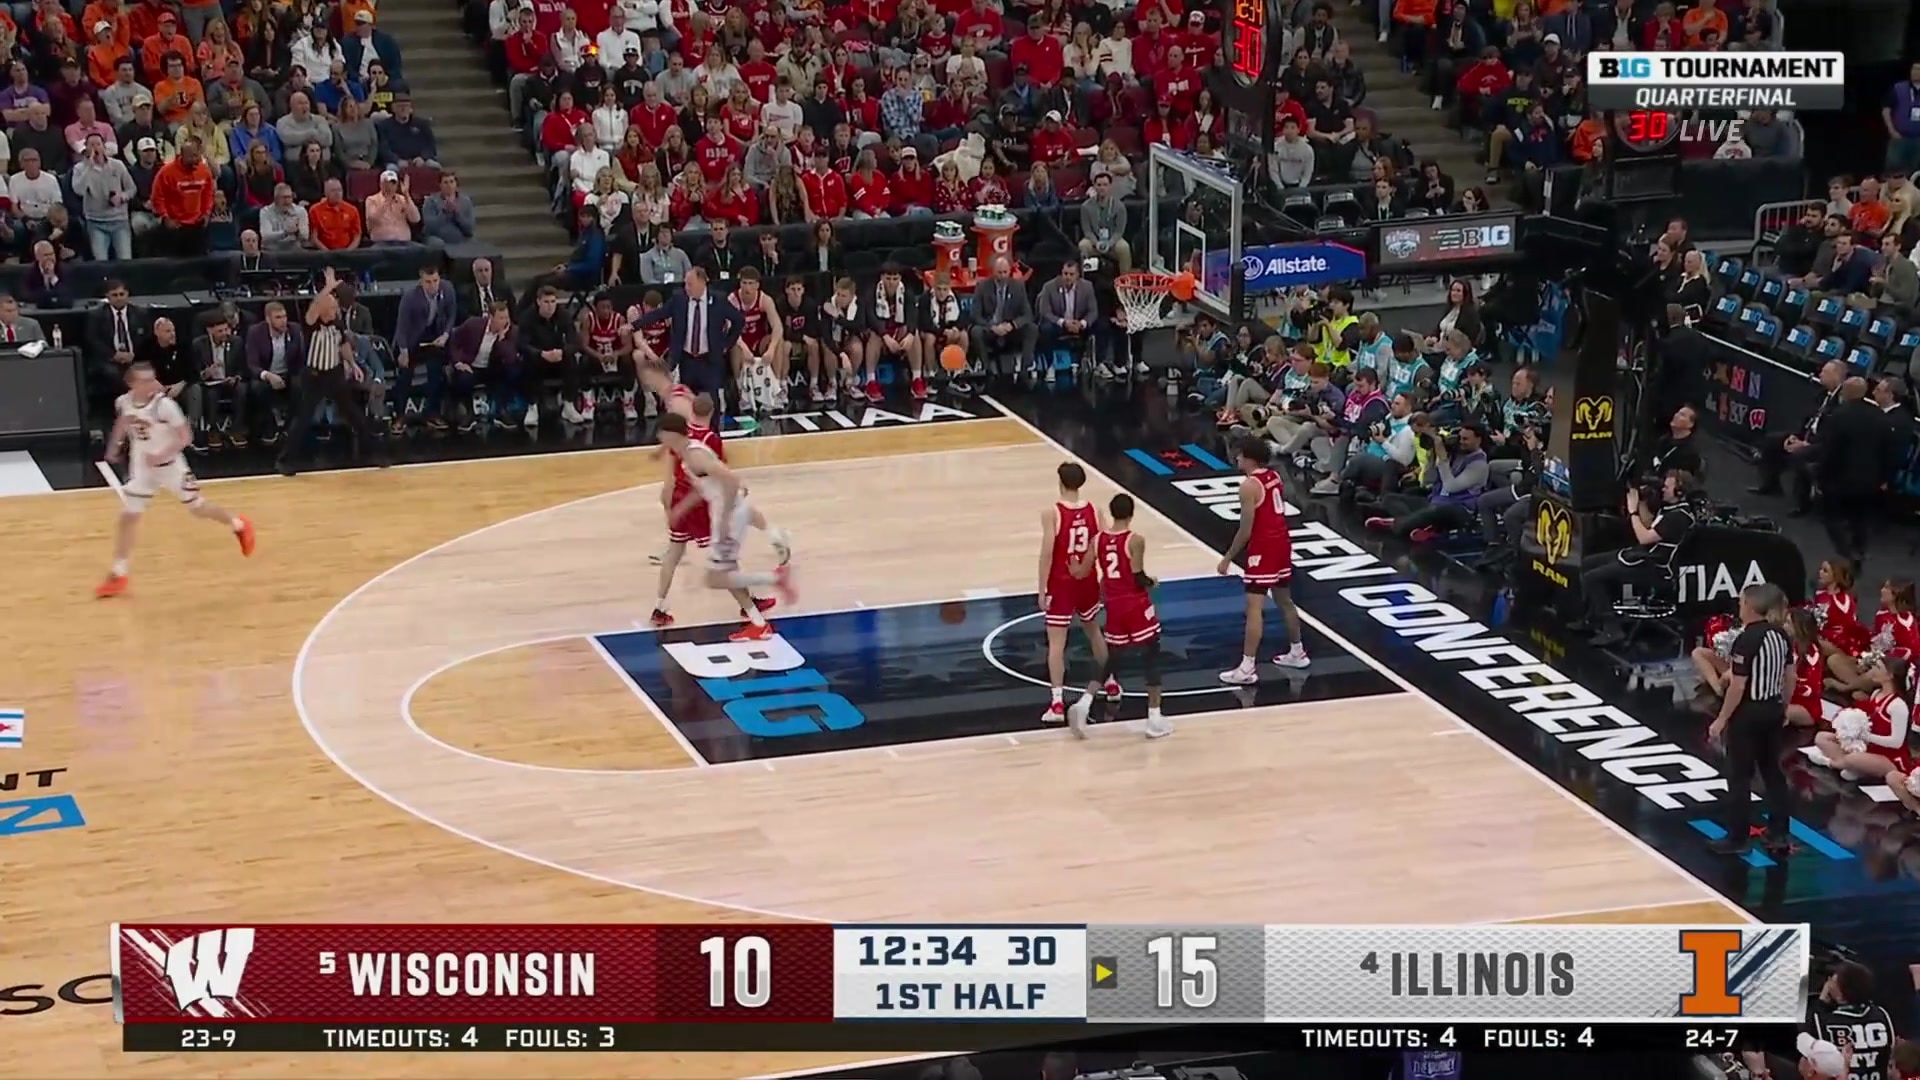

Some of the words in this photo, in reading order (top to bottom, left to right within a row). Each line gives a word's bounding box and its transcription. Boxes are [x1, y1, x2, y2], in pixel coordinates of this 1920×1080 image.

[1233, 20, 1263, 77] 30
[1627, 112, 1668, 141] 30
[993, 236, 1008, 253] G
[1264, 256, 1327, 275] Allstate
[771, 403, 975, 431] TIAA
[1572, 431, 1613, 440] RAM
[1067, 526, 1089, 554] 13
[1289, 521, 1397, 581] TEN
[1106, 552, 1120, 579] 2
[1532, 560, 1568, 588] RAM
[1338, 583, 1762, 809] CONFERENCE
